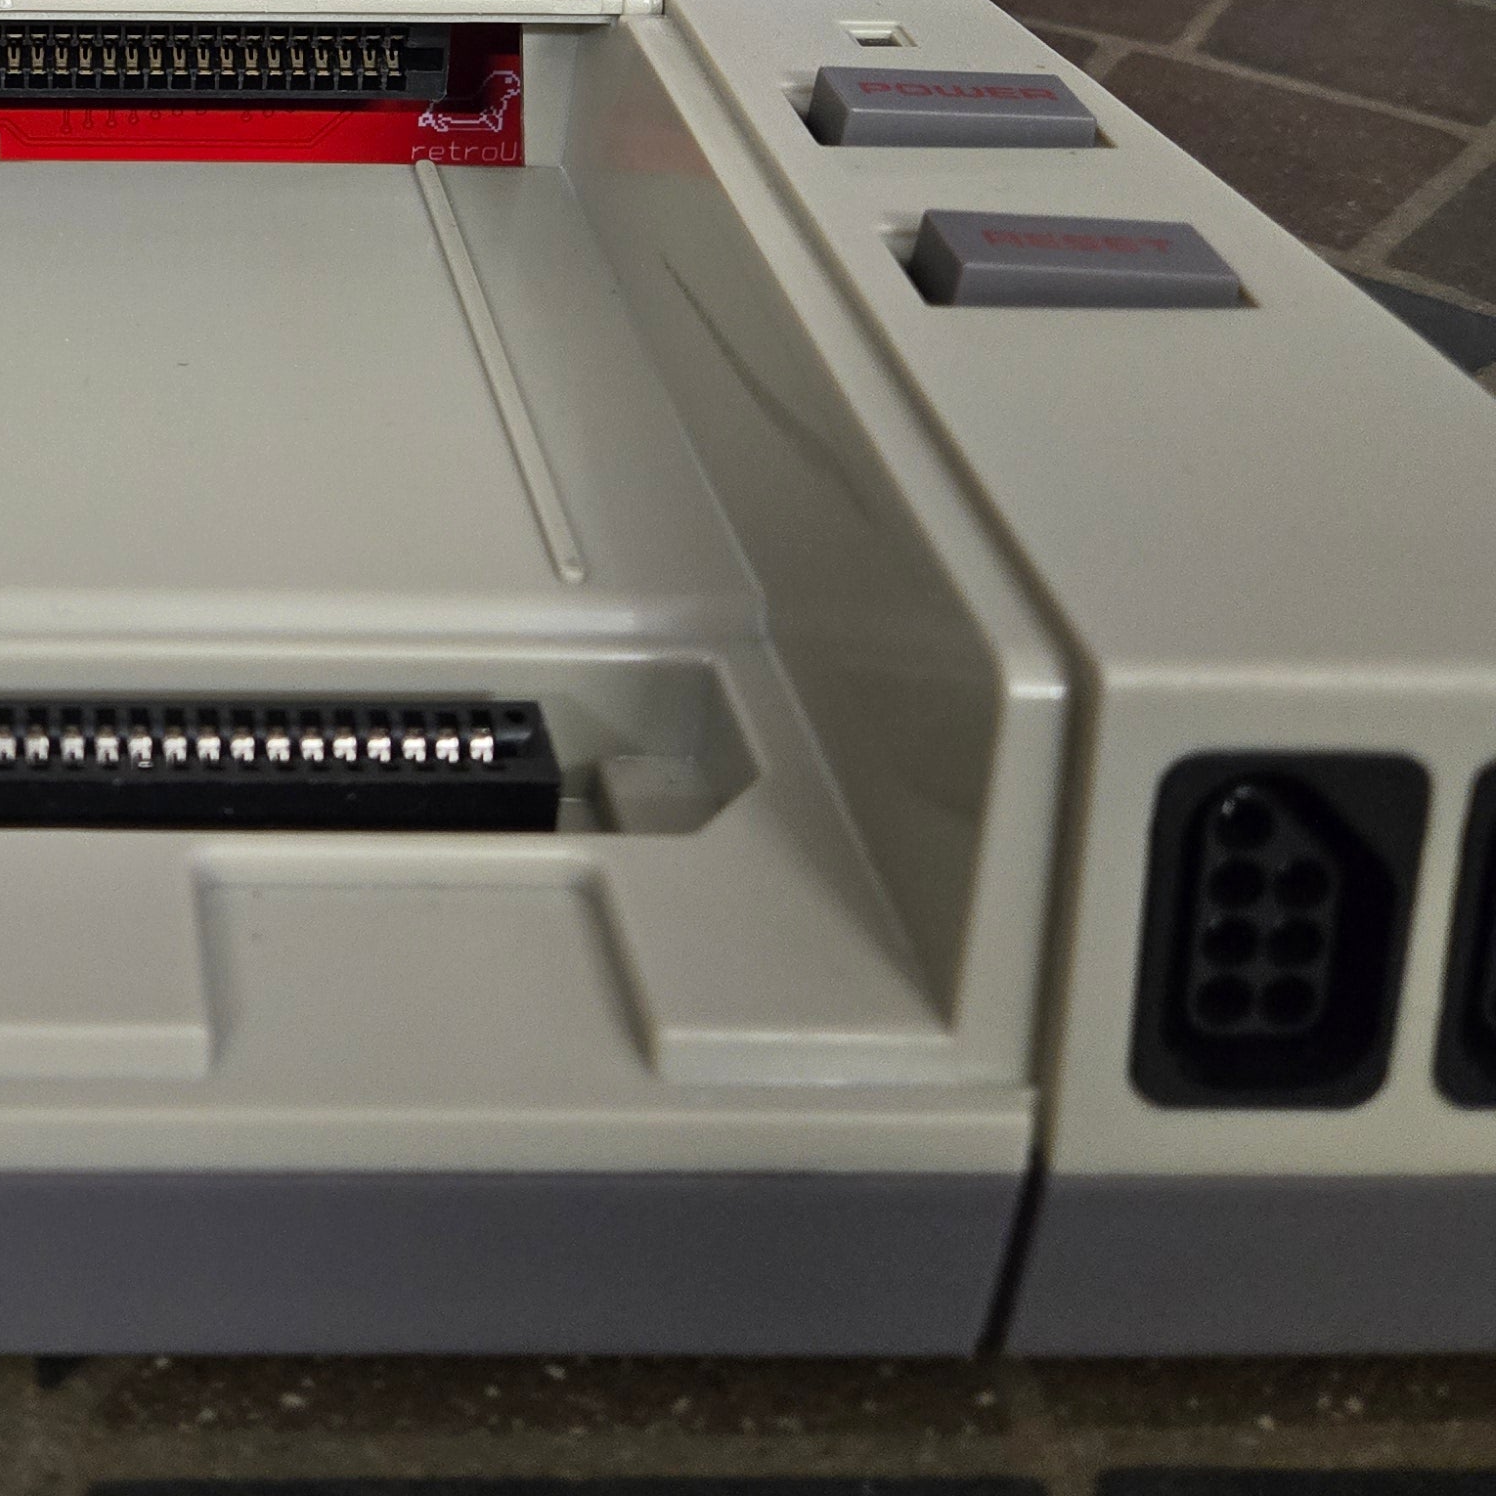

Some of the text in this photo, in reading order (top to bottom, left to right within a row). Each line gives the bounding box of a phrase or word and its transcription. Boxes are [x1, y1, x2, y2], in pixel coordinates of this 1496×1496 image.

[858, 80, 1060, 102] POWER
[411, 140, 523, 163] retroU
[981, 229, 1174, 254] RESET
